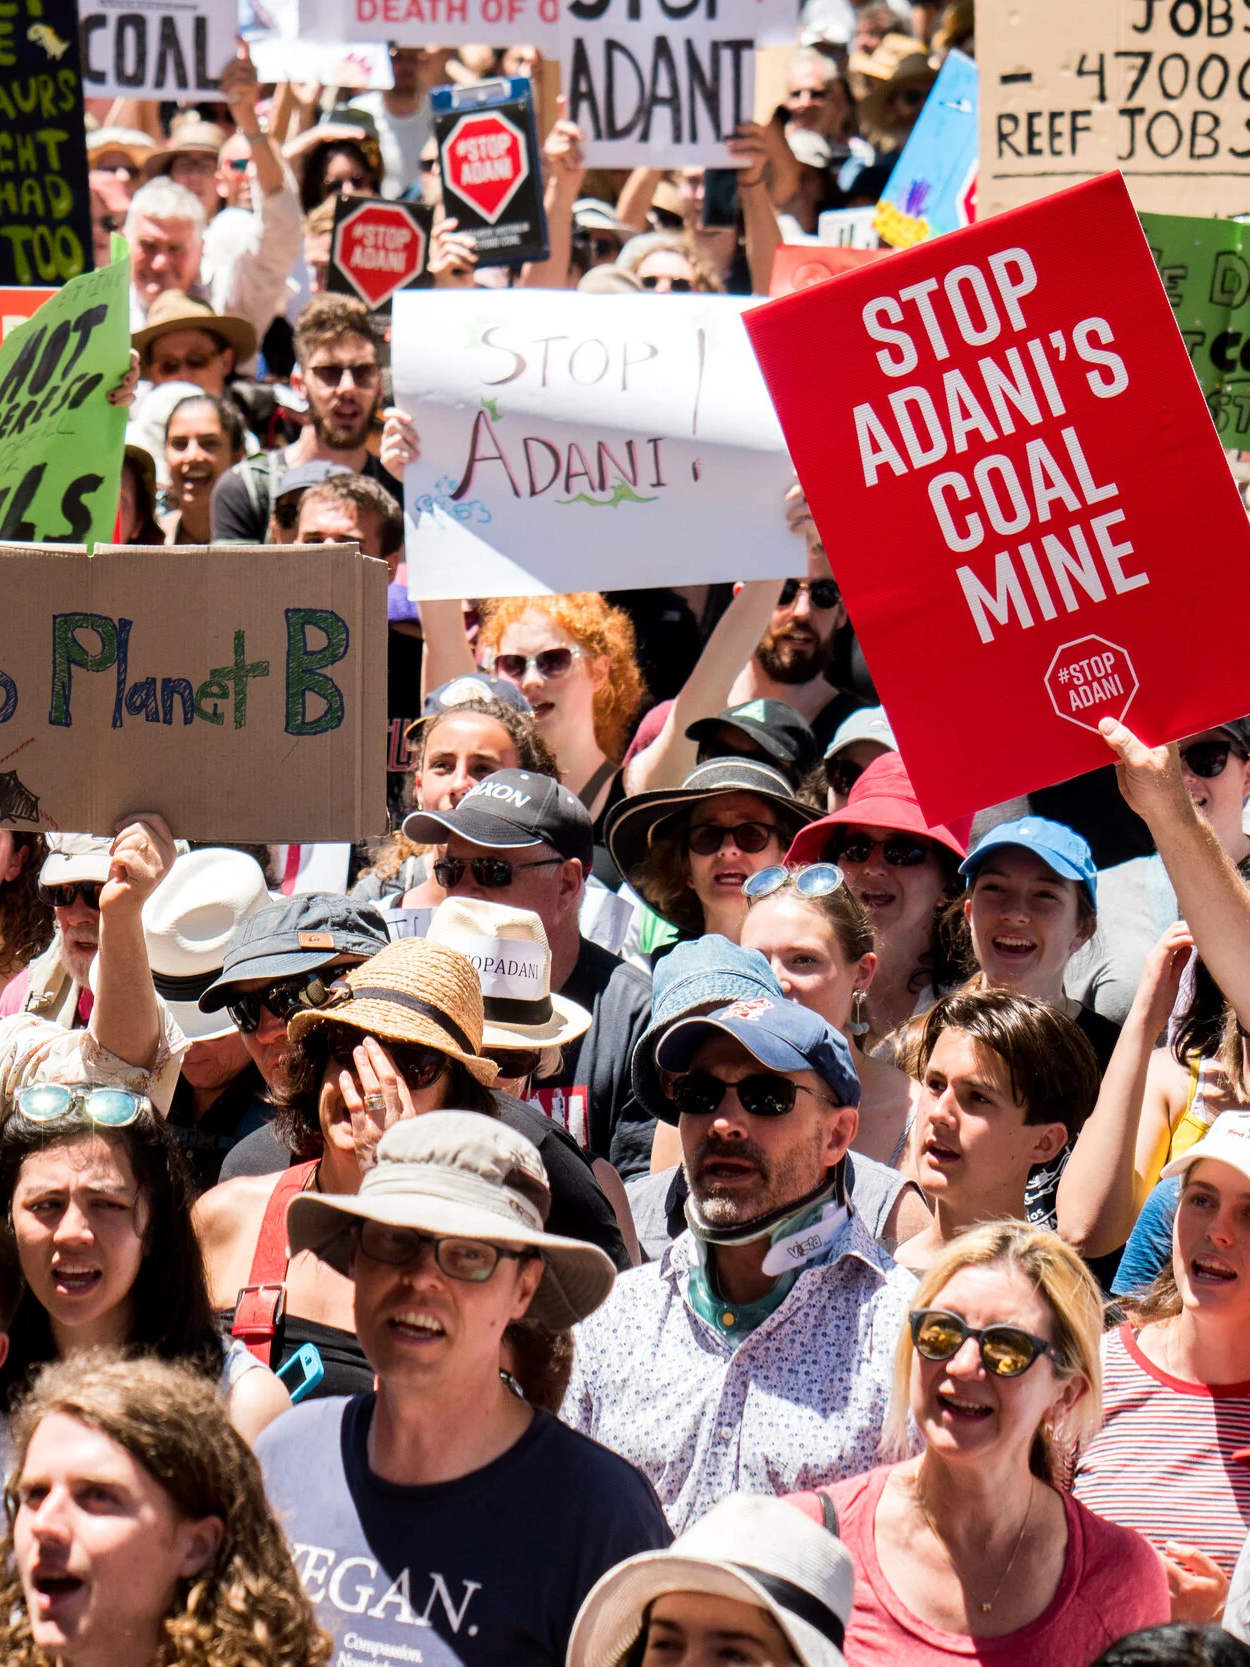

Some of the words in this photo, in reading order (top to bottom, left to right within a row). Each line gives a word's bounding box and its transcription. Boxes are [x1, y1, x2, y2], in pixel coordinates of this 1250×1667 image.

[80, 14, 222, 90] COAL
[457, 132, 512, 162] #STOP
[997, 110, 1092, 159] REEF
[0, 225, 84, 284] TOO
[352, 222, 412, 251] #STOP
[862, 247, 1038, 378] STOP
[480, 326, 659, 392] STOP
[852, 316, 1129, 488] ADANI'S
[448, 408, 668, 501] ADANI
[927, 426, 1120, 553] COAL
[955, 508, 1150, 644] MINE
[49, 612, 270, 730] Planet
[285, 608, 351, 737] B
[1058, 651, 1115, 685] #STOP
[1068, 673, 1125, 712] ADANI
[464, 954, 539, 980] OPADANI
